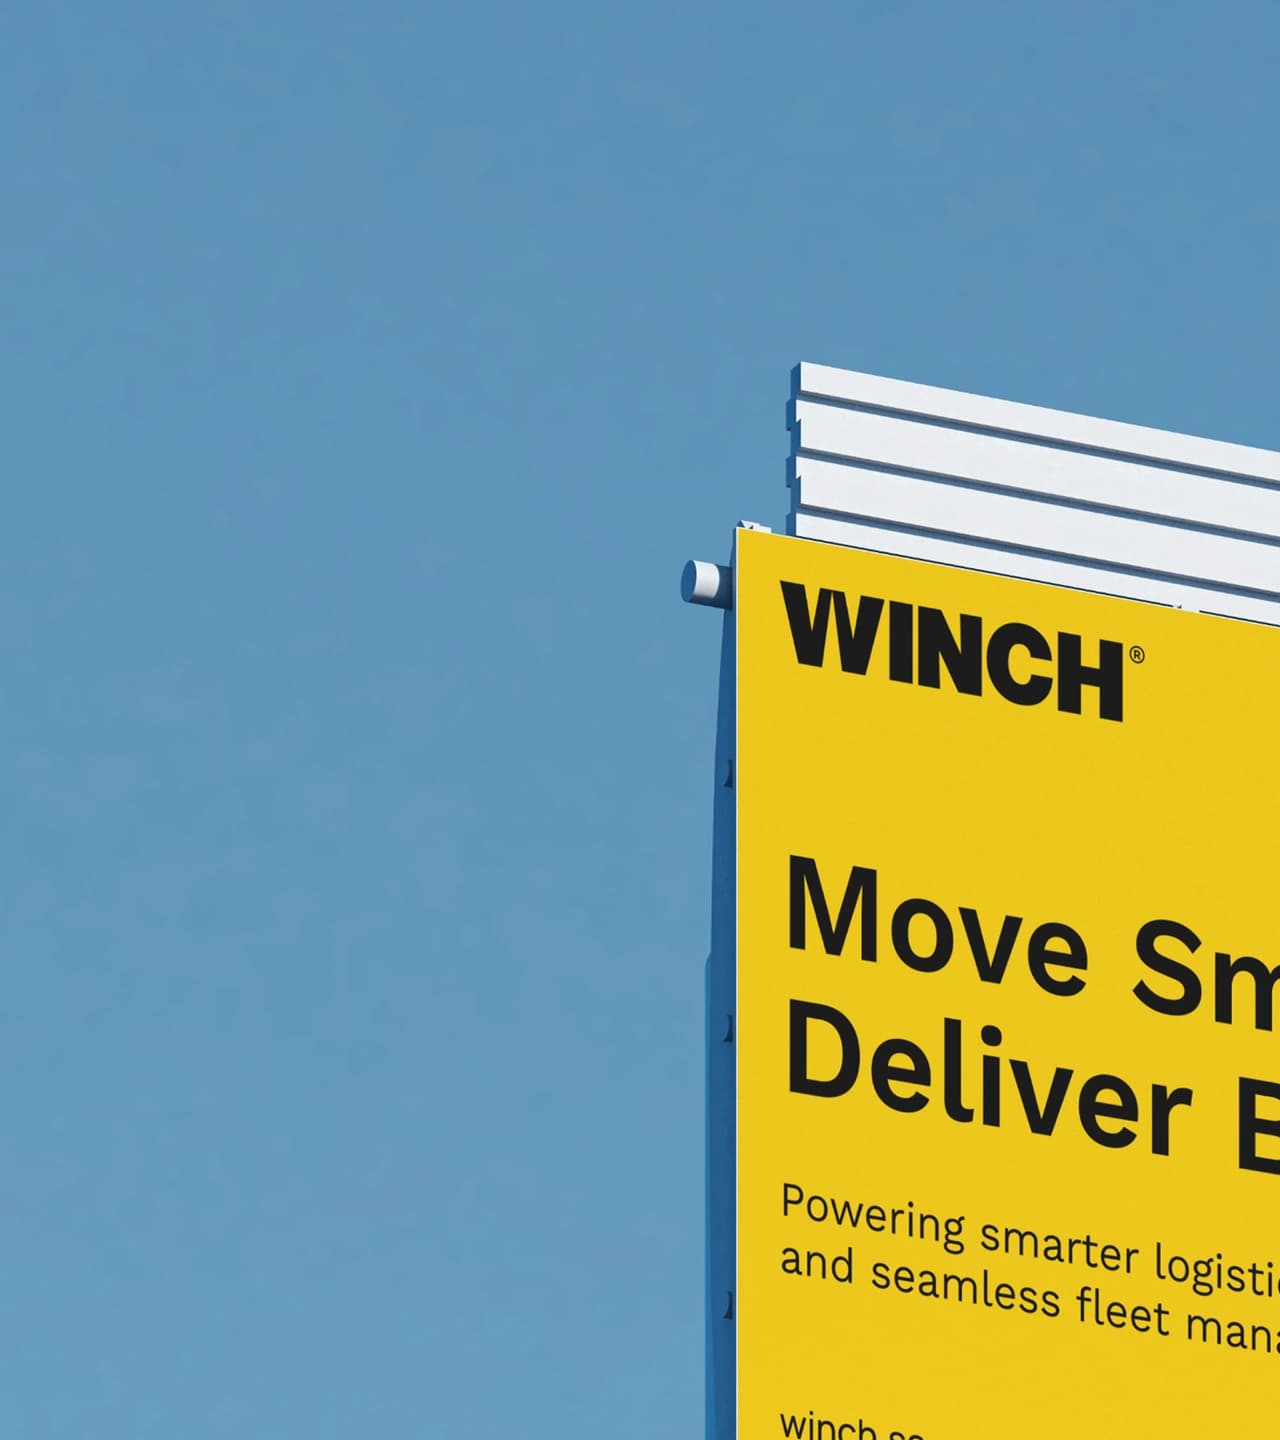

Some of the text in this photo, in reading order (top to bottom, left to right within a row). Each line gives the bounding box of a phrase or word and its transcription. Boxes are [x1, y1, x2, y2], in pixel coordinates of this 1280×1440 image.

[789, 854, 1088, 997] Move
[789, 998, 1194, 1157] Deliver
[782, 1183, 966, 1255] Powering
[980, 1220, 1141, 1274] smarter
[781, 1246, 853, 1284] and
[871, 1262, 1060, 1318] seamless
[1075, 1286, 1170, 1337] fleet
